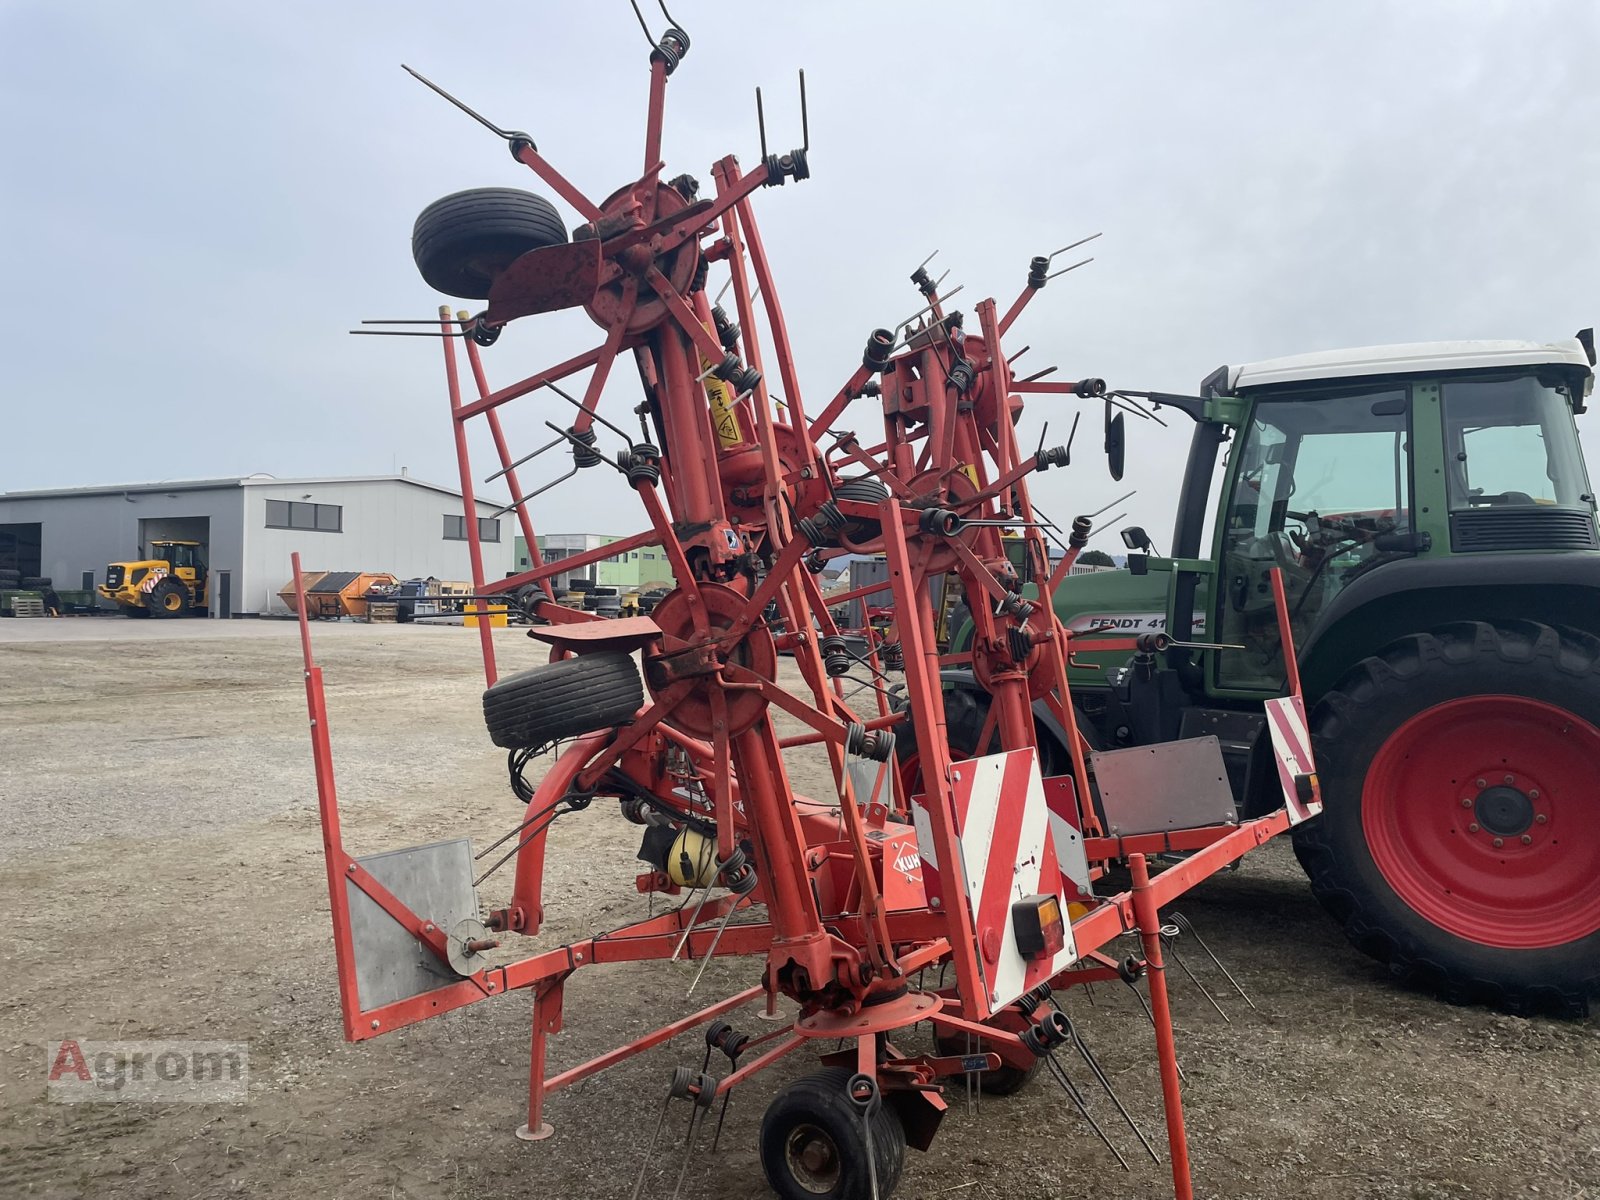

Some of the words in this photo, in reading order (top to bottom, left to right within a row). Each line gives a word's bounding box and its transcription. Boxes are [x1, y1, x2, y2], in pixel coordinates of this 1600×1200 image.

[1089, 618, 1143, 628] FENDT
[1147, 618, 1167, 628] 41
[897, 852, 921, 872] KUH
